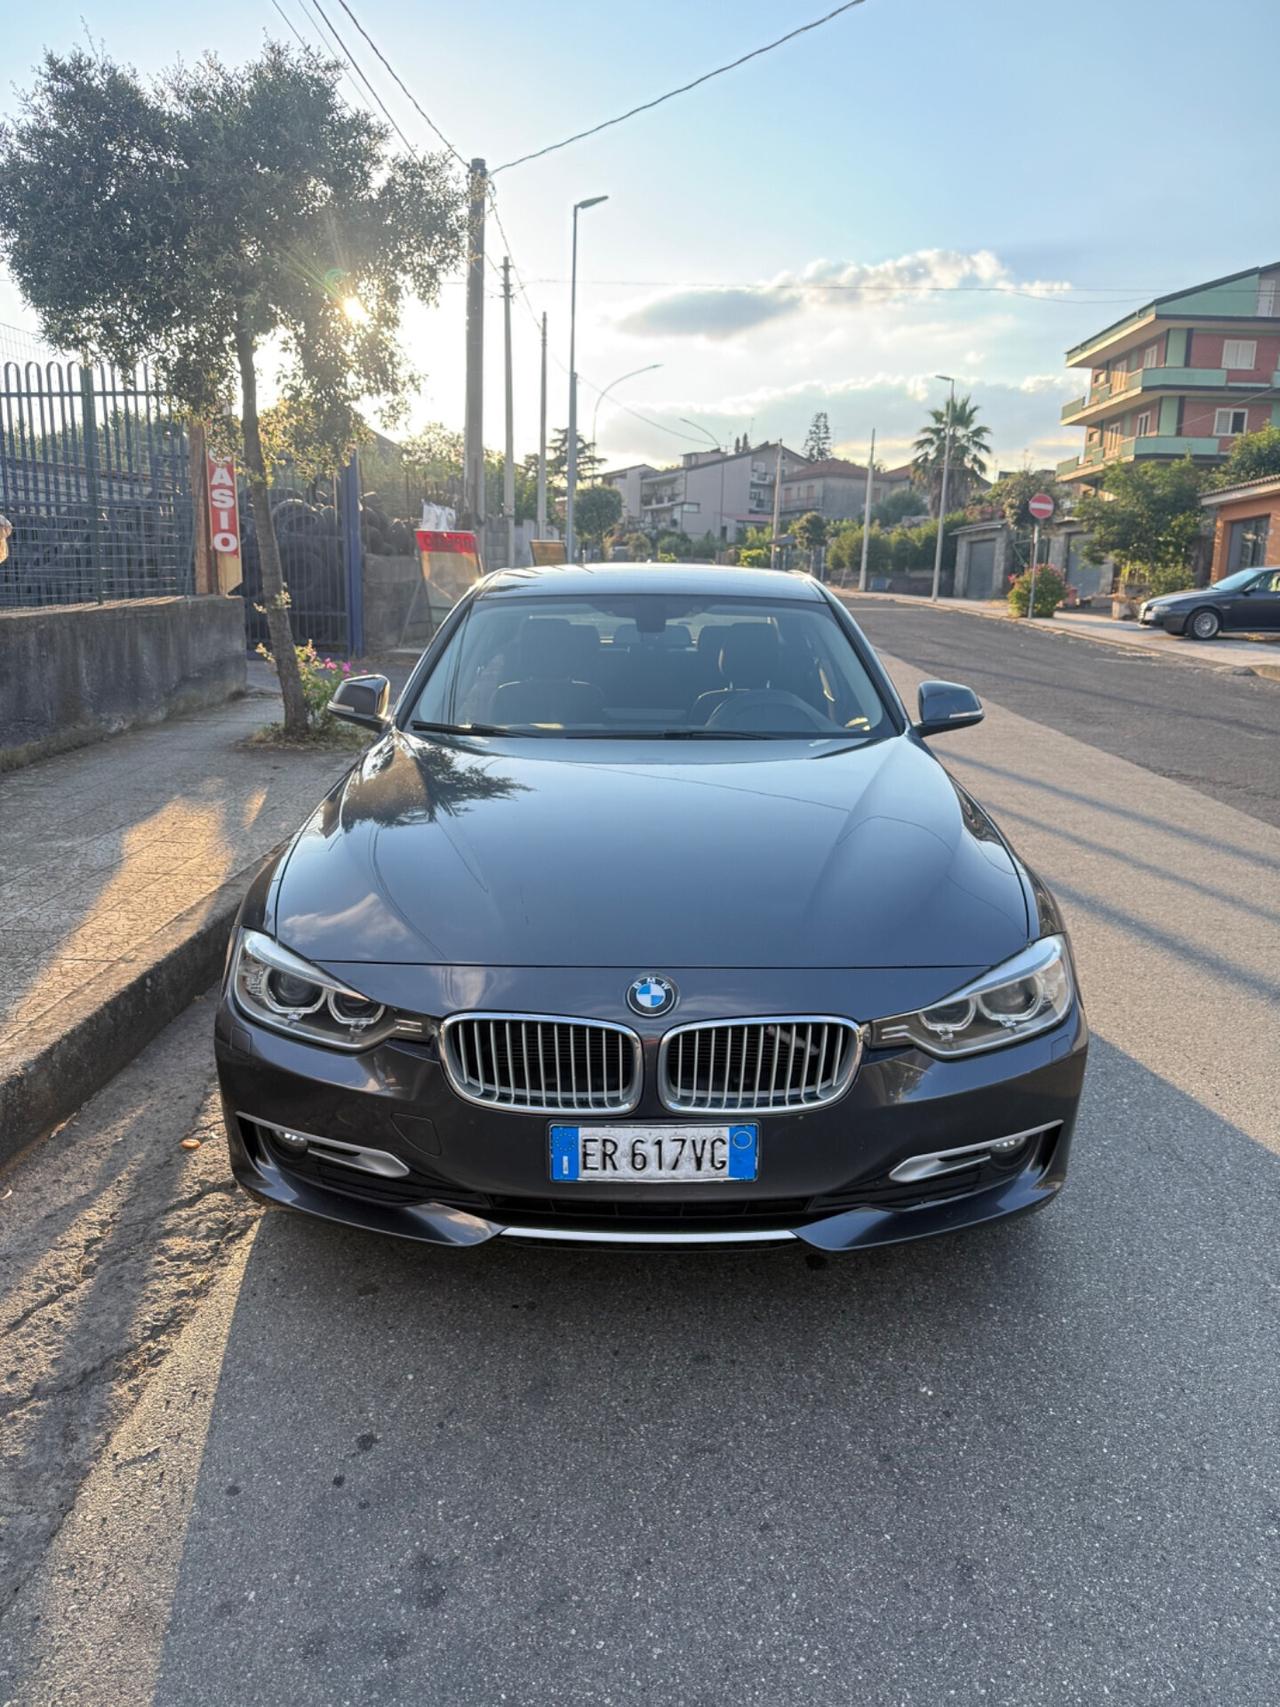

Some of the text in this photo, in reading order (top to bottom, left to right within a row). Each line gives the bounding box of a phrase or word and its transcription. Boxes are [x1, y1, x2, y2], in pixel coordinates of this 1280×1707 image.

[632, 976, 671, 990] BMW
[582, 1138, 727, 1171] ER 617VG
